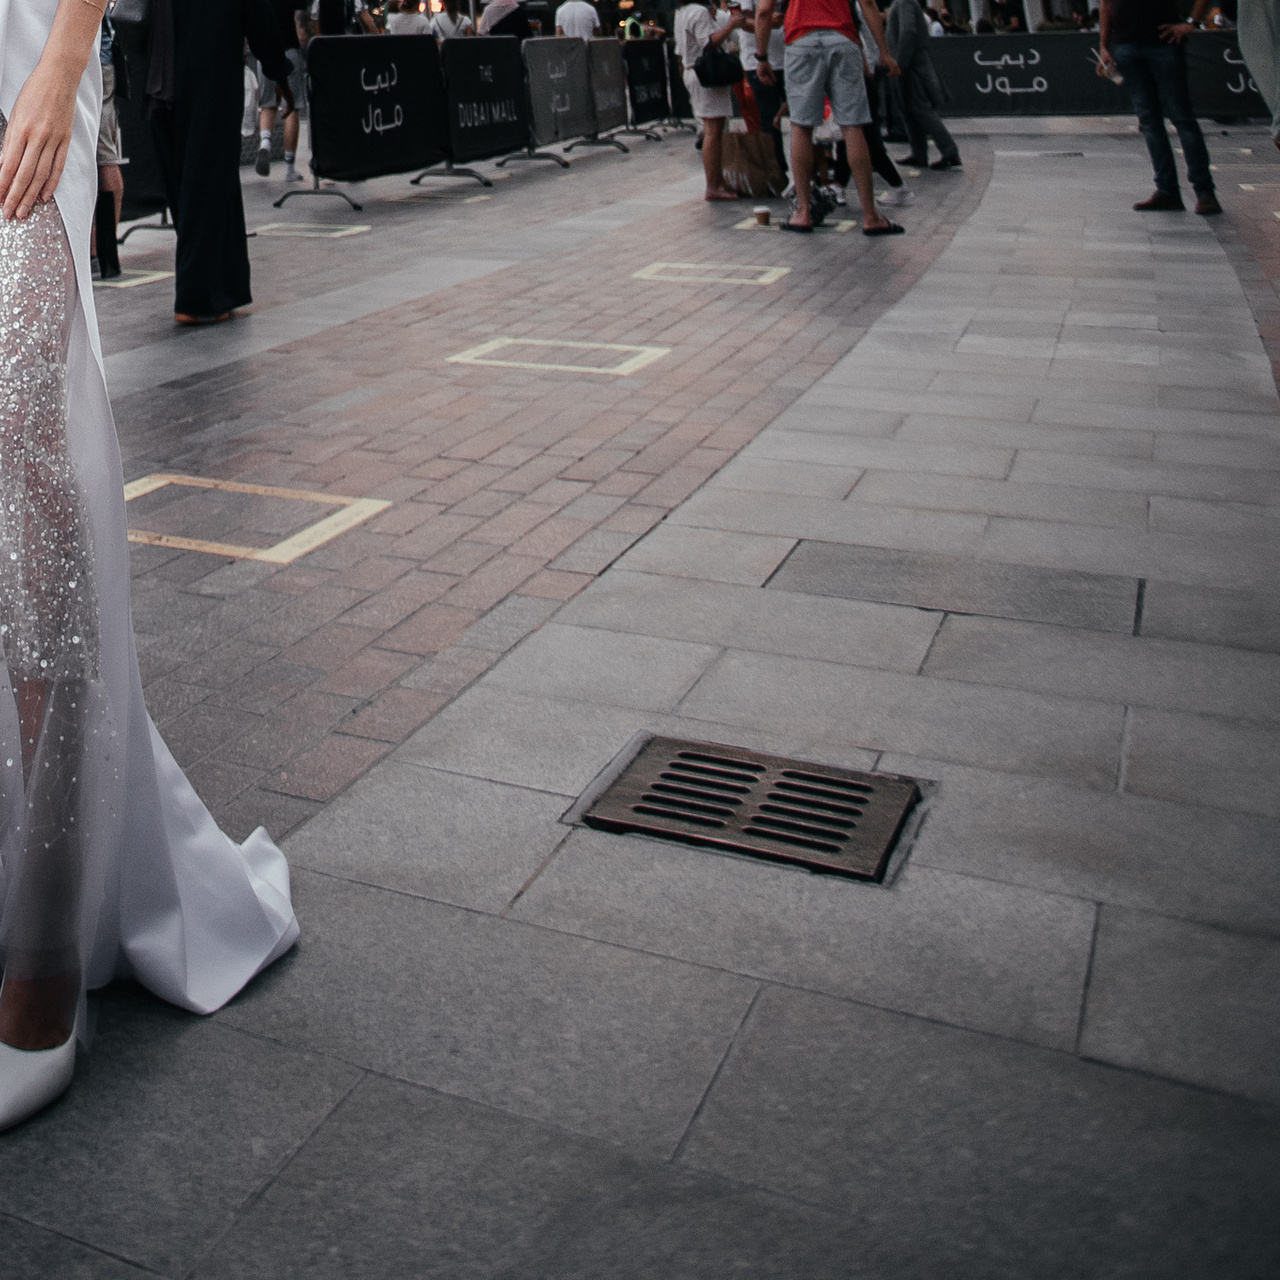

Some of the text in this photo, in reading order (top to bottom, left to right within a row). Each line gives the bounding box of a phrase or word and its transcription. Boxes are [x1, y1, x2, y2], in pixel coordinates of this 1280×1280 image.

[974, 47, 1041, 70] دبي
[360, 62, 397, 95] دبي
[975, 72, 1049, 96] مول
[361, 102, 404, 136] مول
[458, 98, 518, 129] DUBAI MALL
